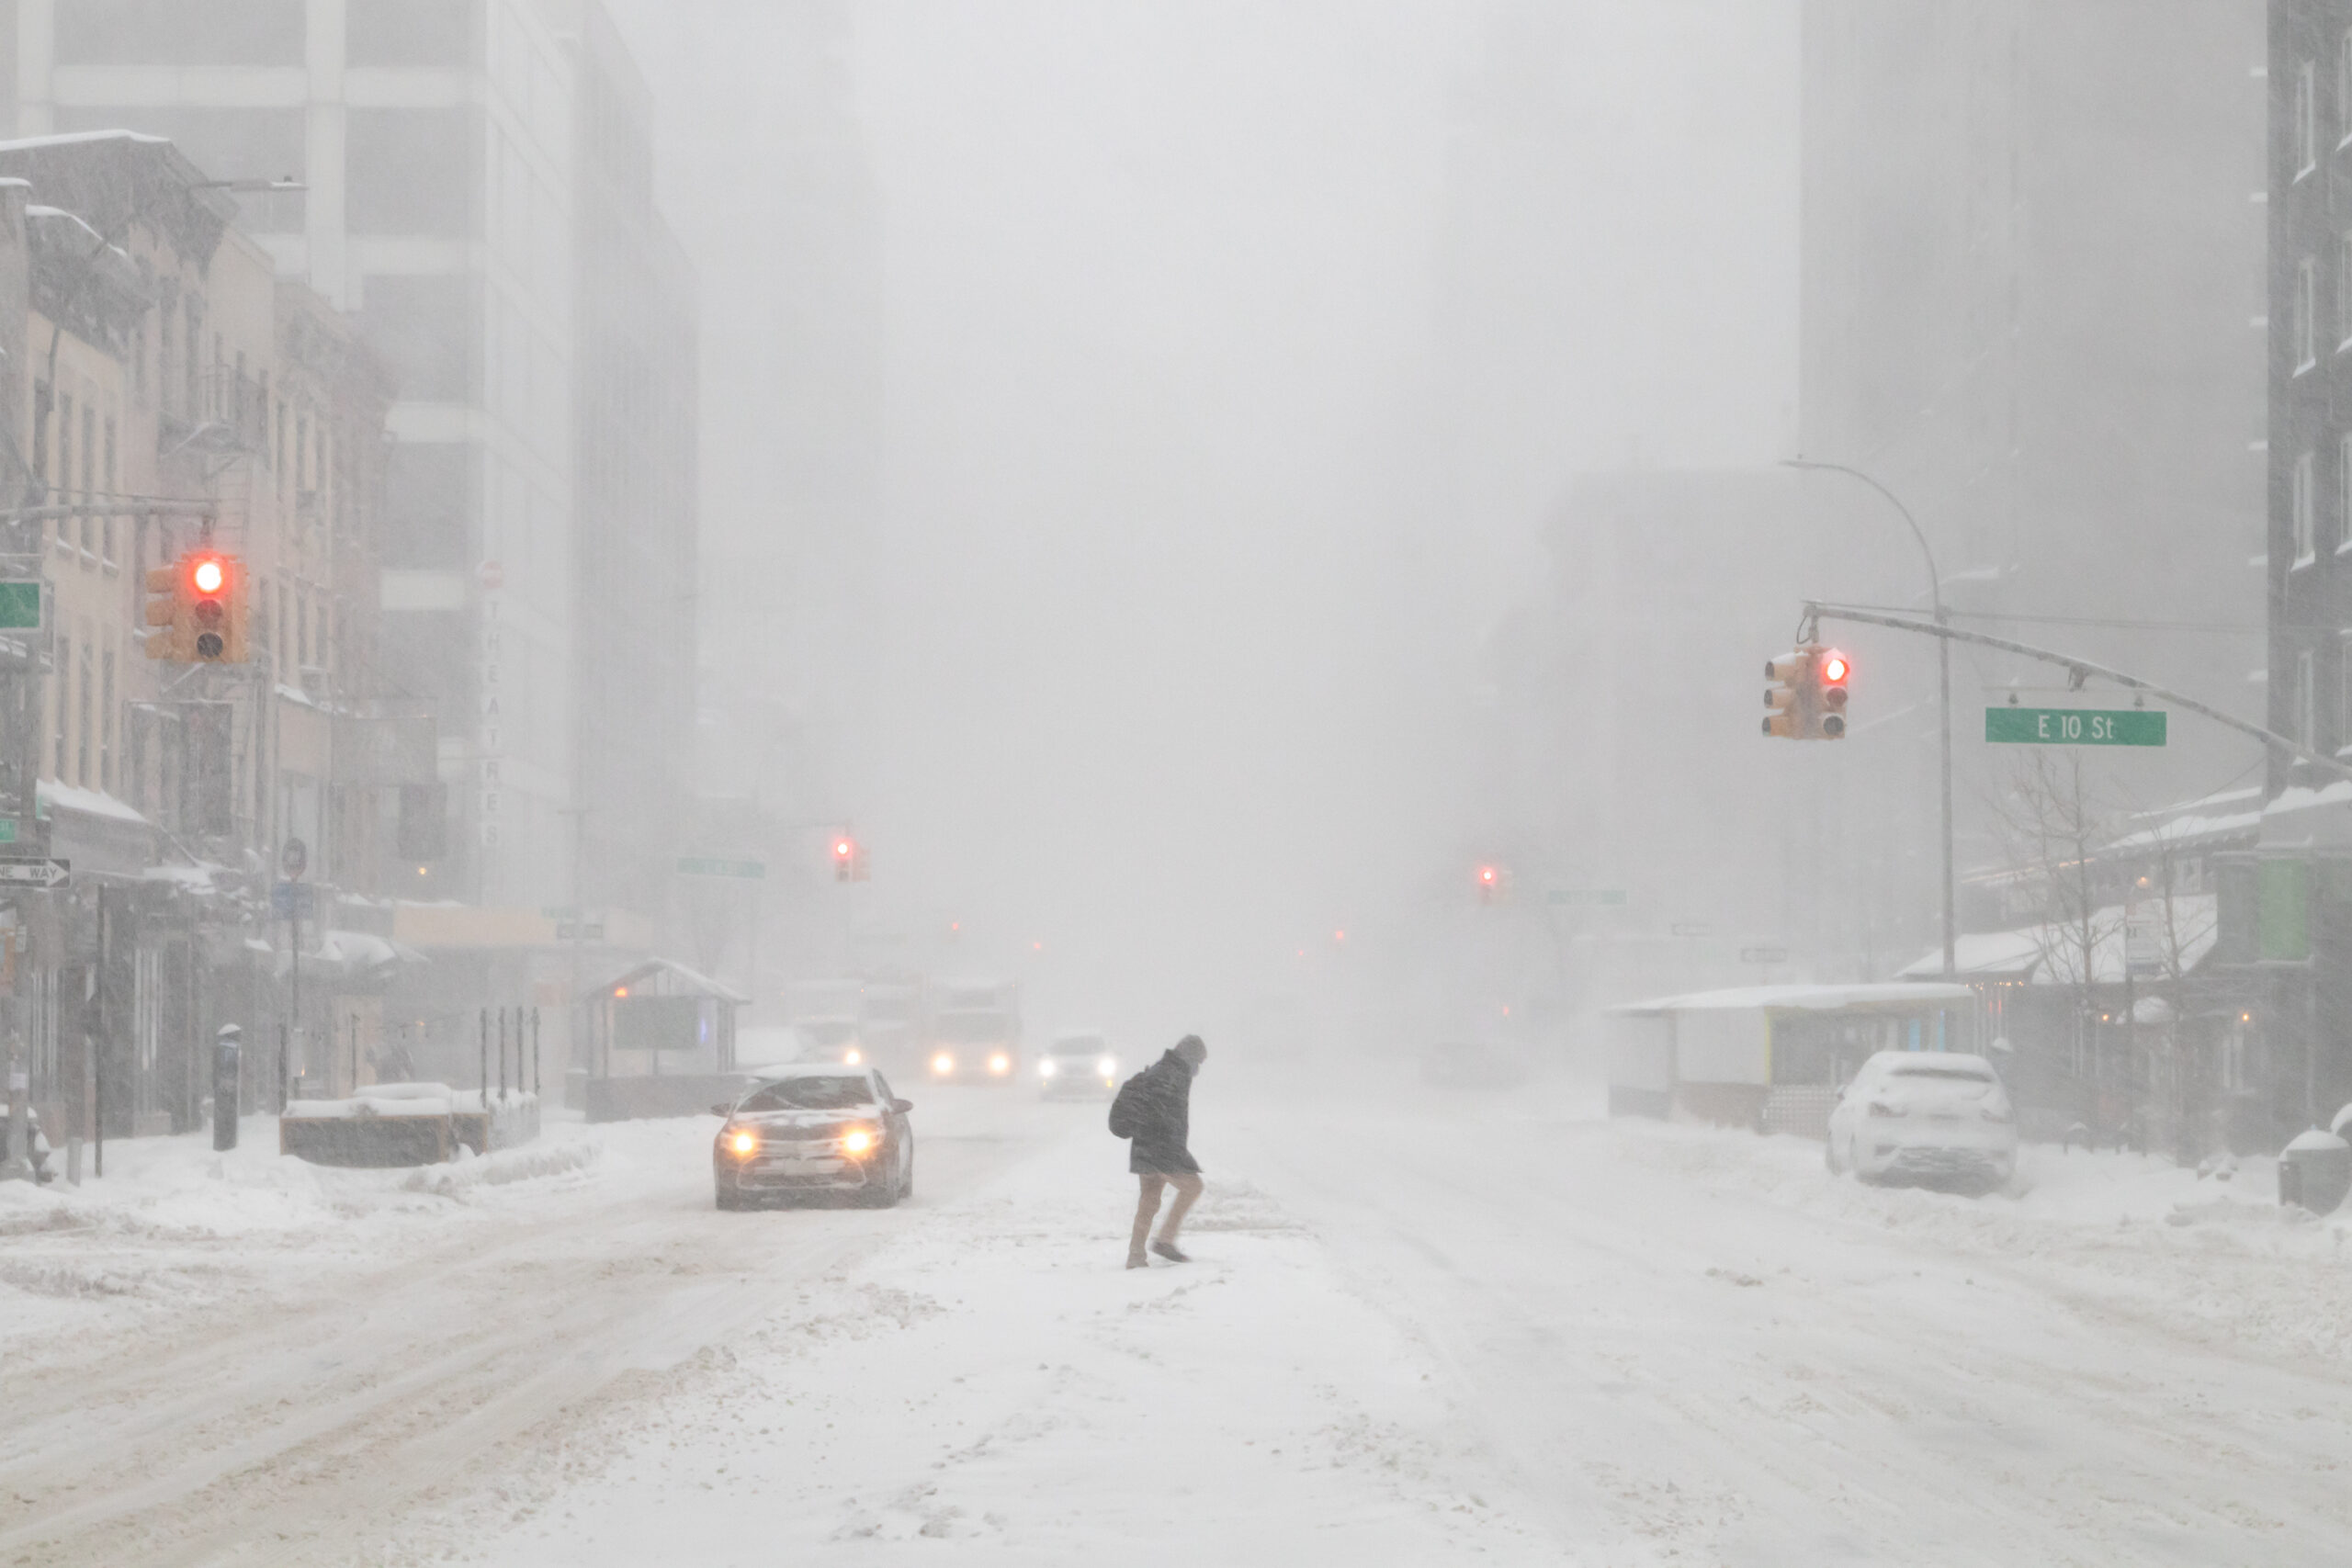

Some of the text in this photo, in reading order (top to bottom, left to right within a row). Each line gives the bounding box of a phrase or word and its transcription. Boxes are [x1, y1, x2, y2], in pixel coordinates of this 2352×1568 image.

[485, 600, 500, 844] THEATRES
[2038, 715, 2114, 739] E 10 St
[0, 868, 57, 878] NE WAY
